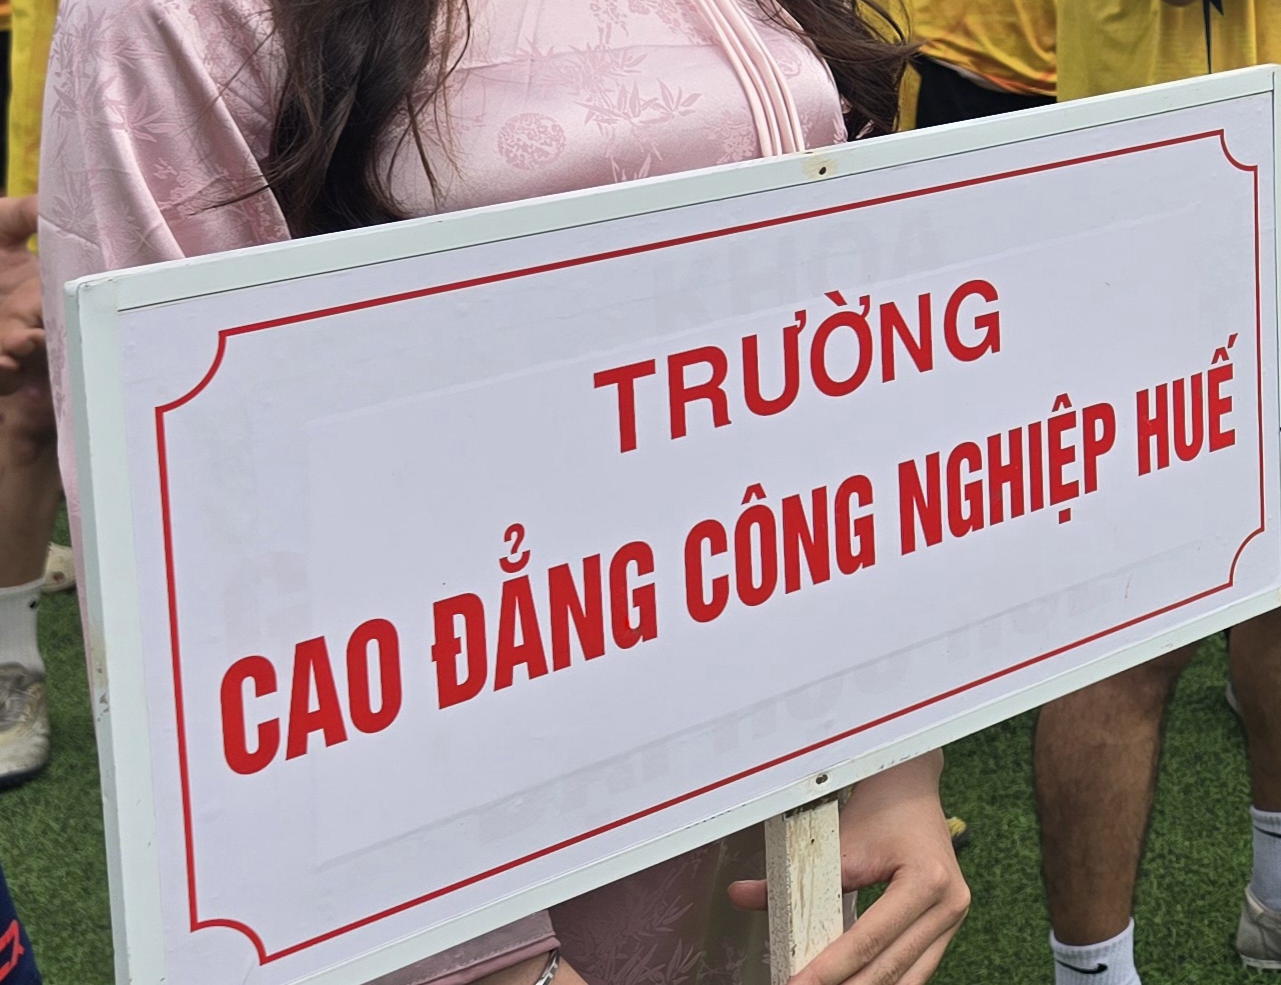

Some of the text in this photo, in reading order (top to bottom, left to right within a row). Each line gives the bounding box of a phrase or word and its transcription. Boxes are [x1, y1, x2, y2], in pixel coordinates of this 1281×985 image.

[593, 279, 1001, 453] TRƯỜNG
[220, 618, 402, 776] CAO
[431, 523, 658, 709] ĐẲNG
[684, 483, 876, 623] CÔNG
[898, 393, 1116, 555] NGHIỆP
[1136, 333, 1240, 476] HUẾ
